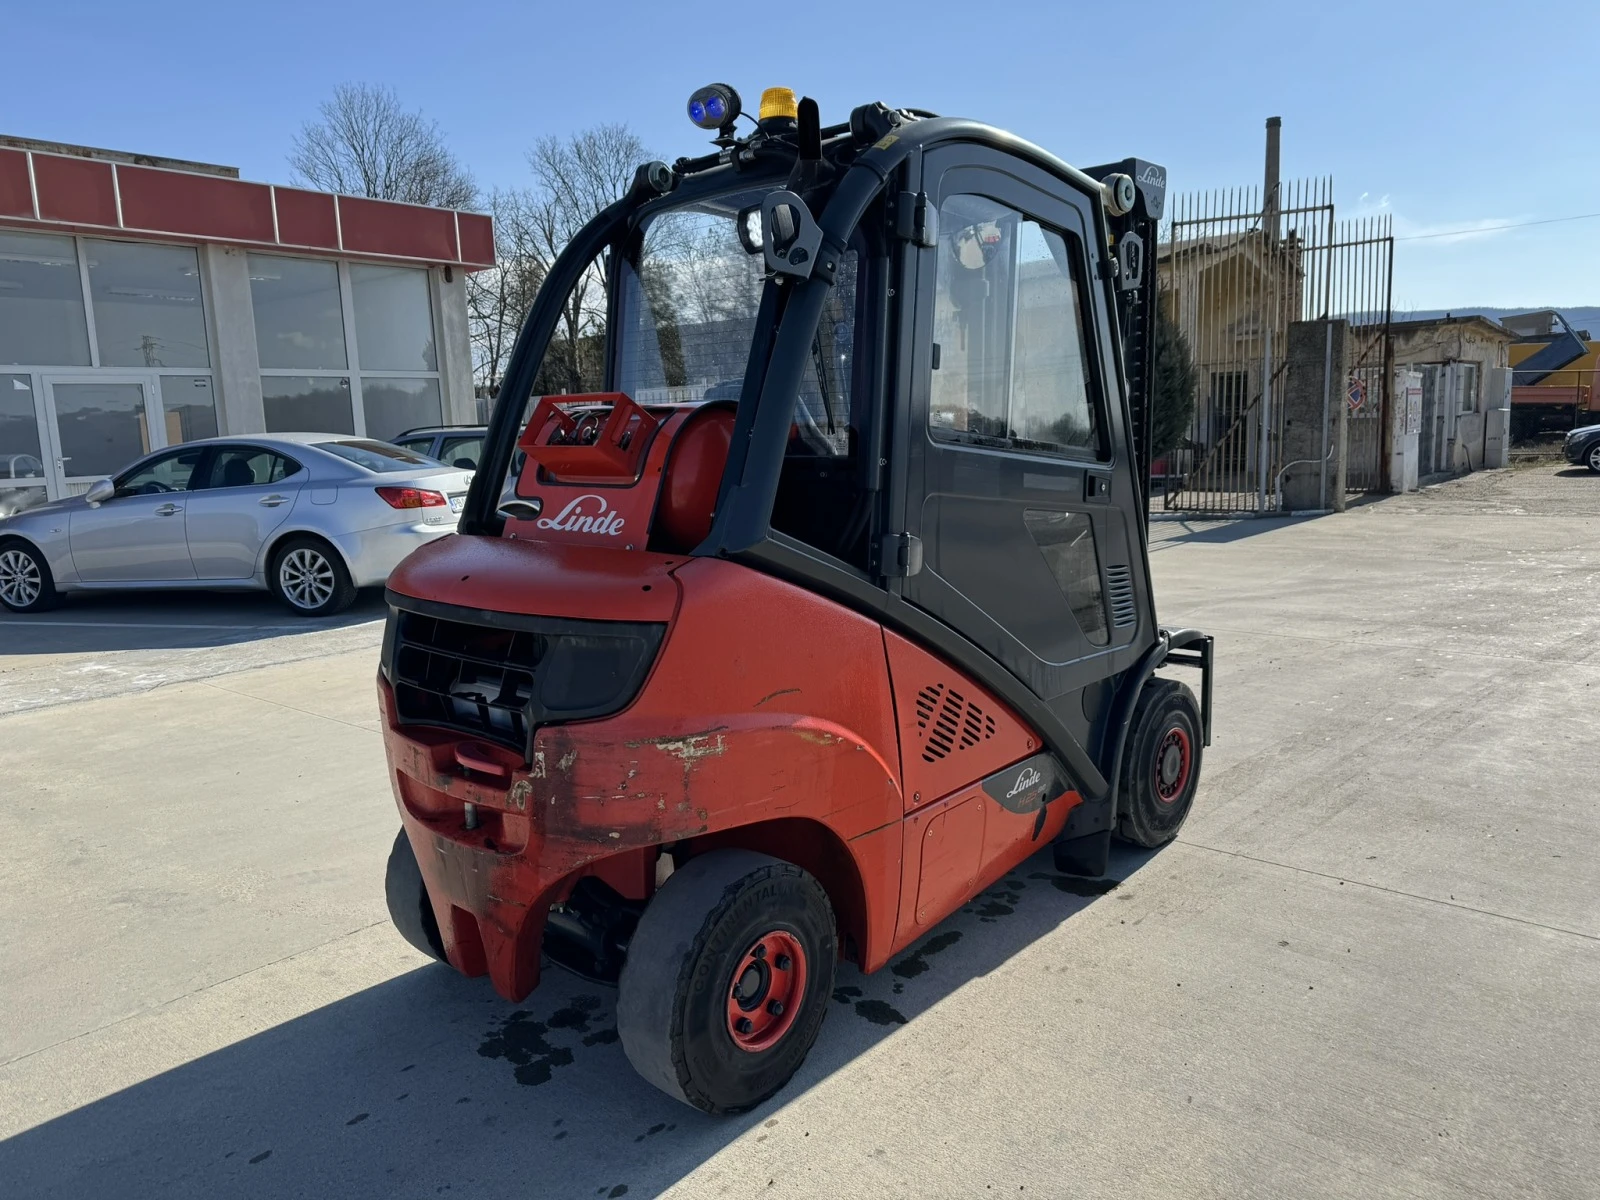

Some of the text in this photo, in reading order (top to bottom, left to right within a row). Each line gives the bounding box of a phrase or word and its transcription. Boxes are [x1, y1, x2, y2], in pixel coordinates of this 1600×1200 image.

[1137, 165, 1165, 189] Linde
[537, 494, 625, 535] Linde
[1006, 767, 1041, 798] Linde
